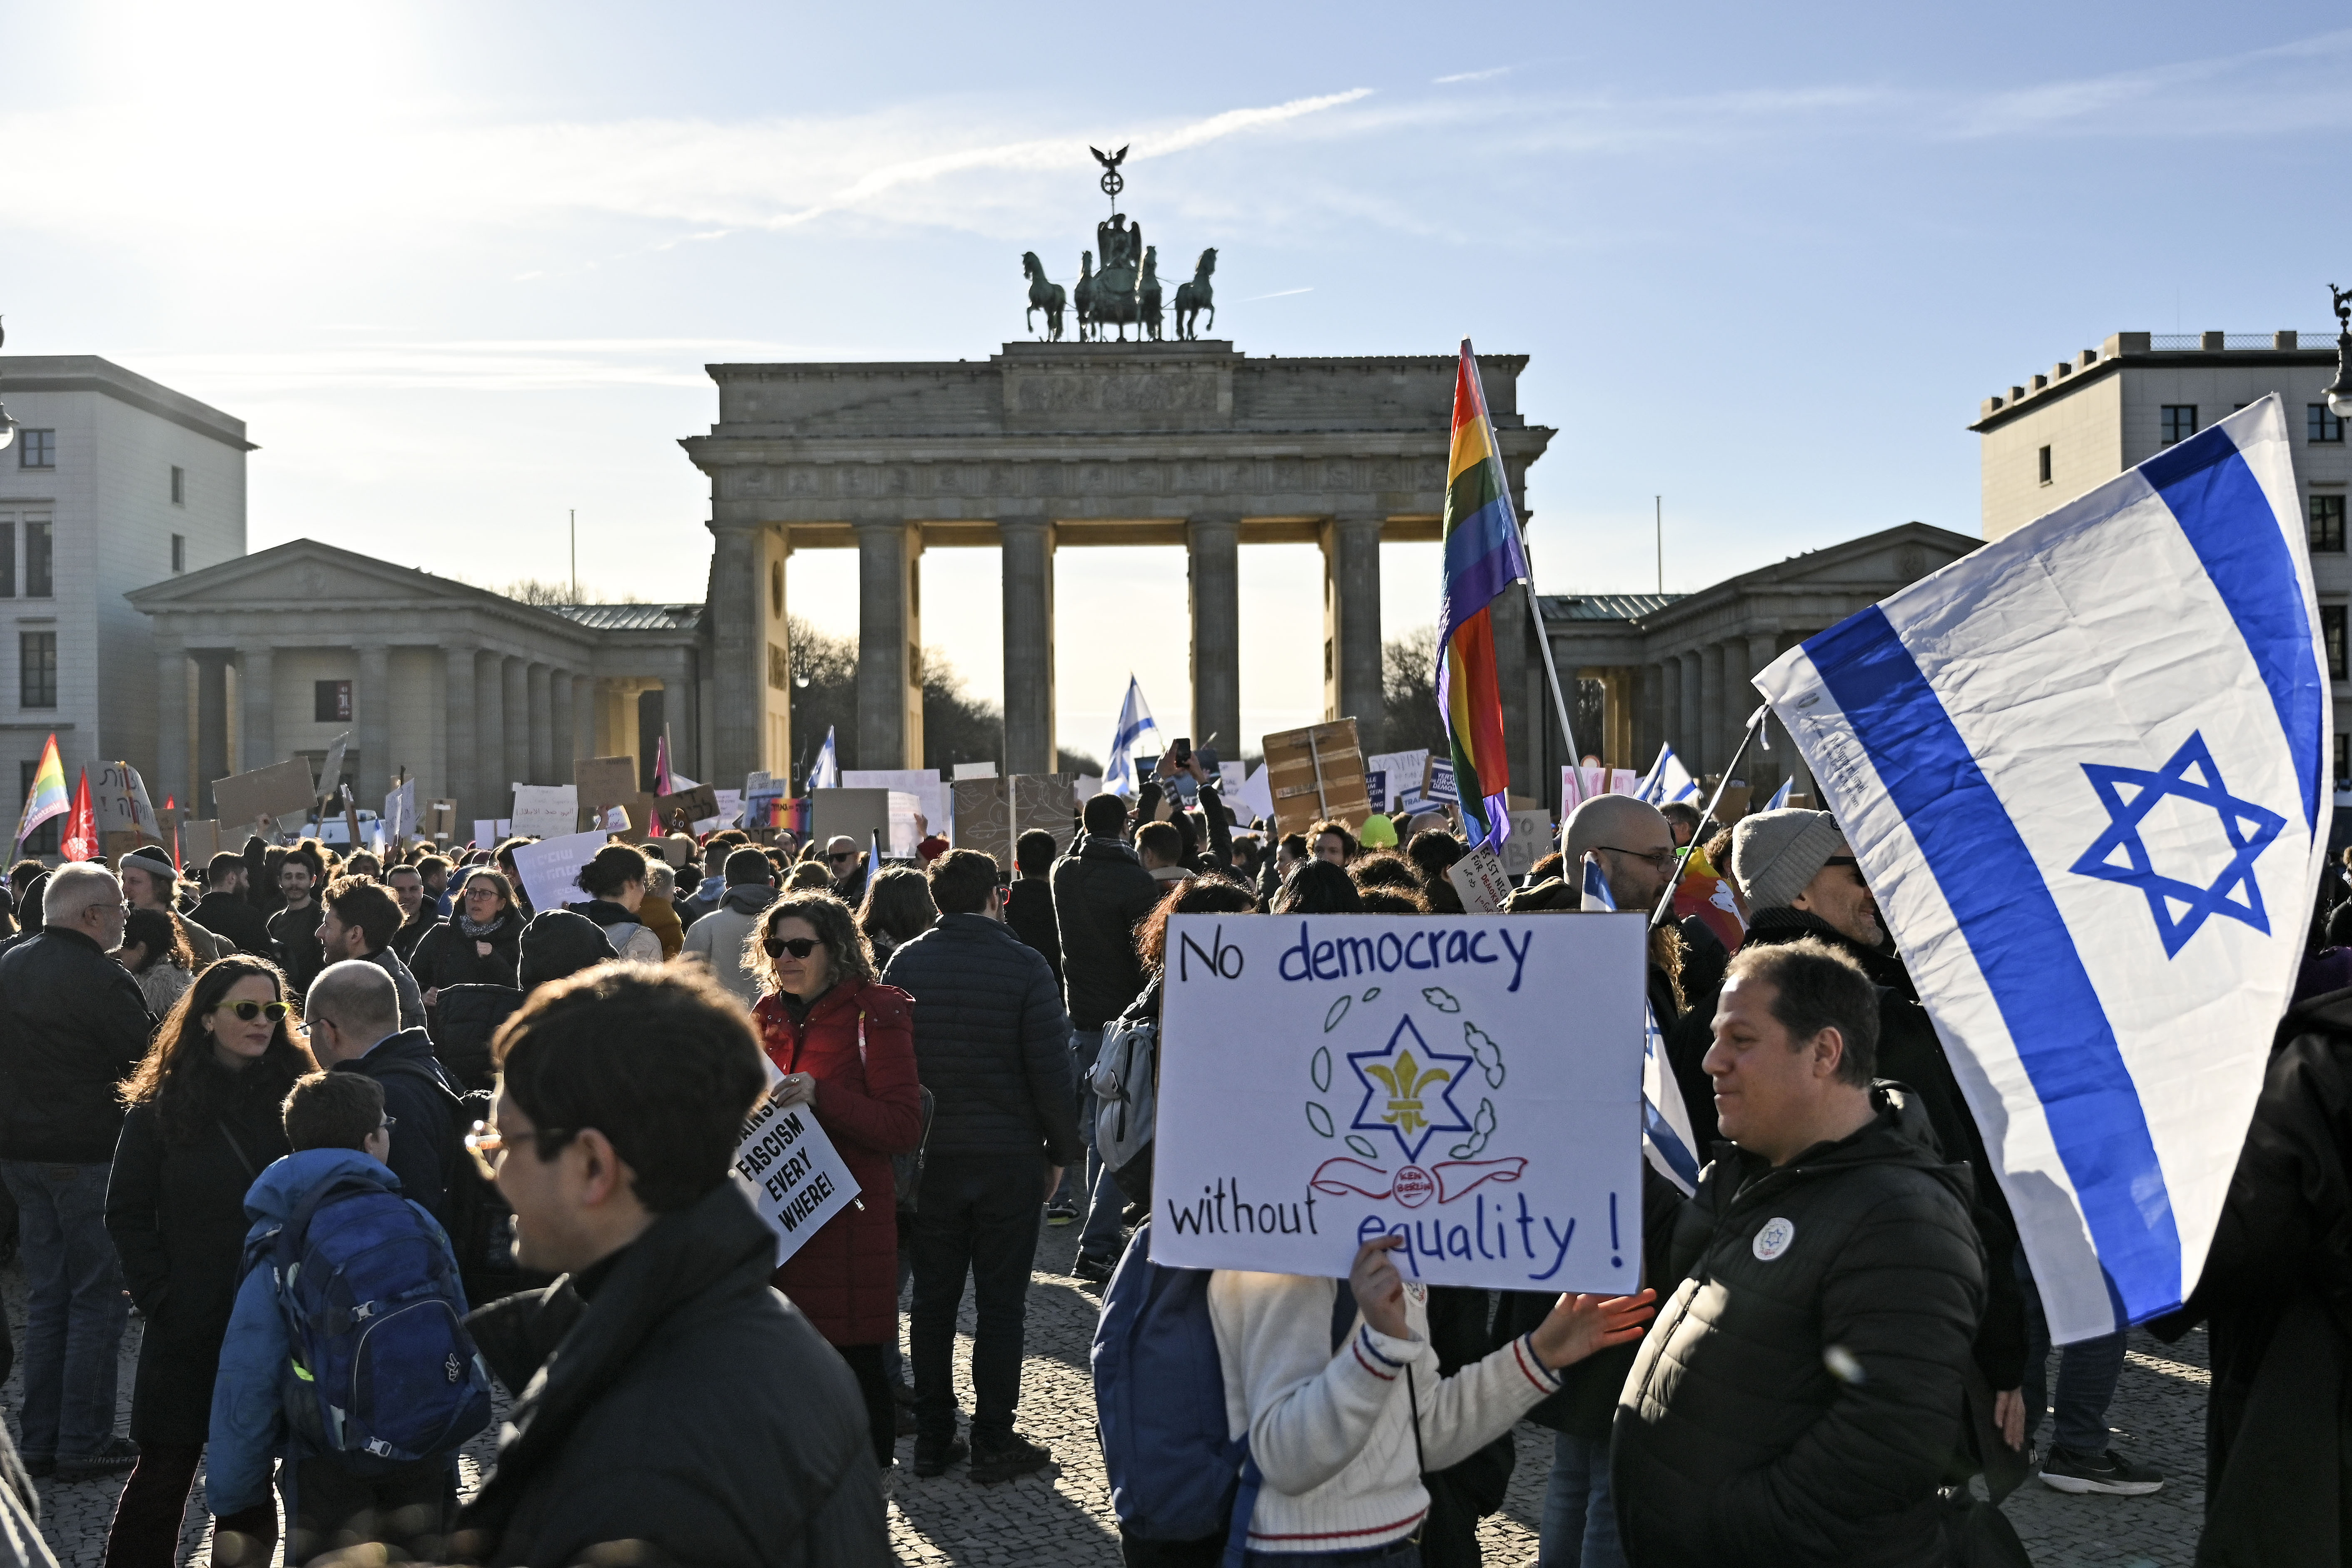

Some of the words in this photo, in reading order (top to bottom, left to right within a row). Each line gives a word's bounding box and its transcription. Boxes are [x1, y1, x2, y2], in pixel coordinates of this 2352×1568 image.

[1437, 778, 1455, 786] ISRA
[1438, 773, 1453, 782] VERT
[1850, 771, 1869, 794] Israel
[1509, 817, 1534, 836] TO
[1480, 846, 1490, 859] ES
[1486, 859, 1499, 876] IST
[1495, 877, 1509, 899] NICH
[1500, 841, 1534, 867] IBI
[1181, 924, 1244, 982] No
[1279, 920, 1533, 993] democracy
[735, 1111, 805, 1182] FASCISM
[765, 1146, 812, 1202] EVERY
[1400, 1171, 1421, 1180] KEN
[778, 1171, 835, 1233] WHERE!
[1168, 1177, 1318, 1235] without
[1357, 1192, 1576, 1280] equality
